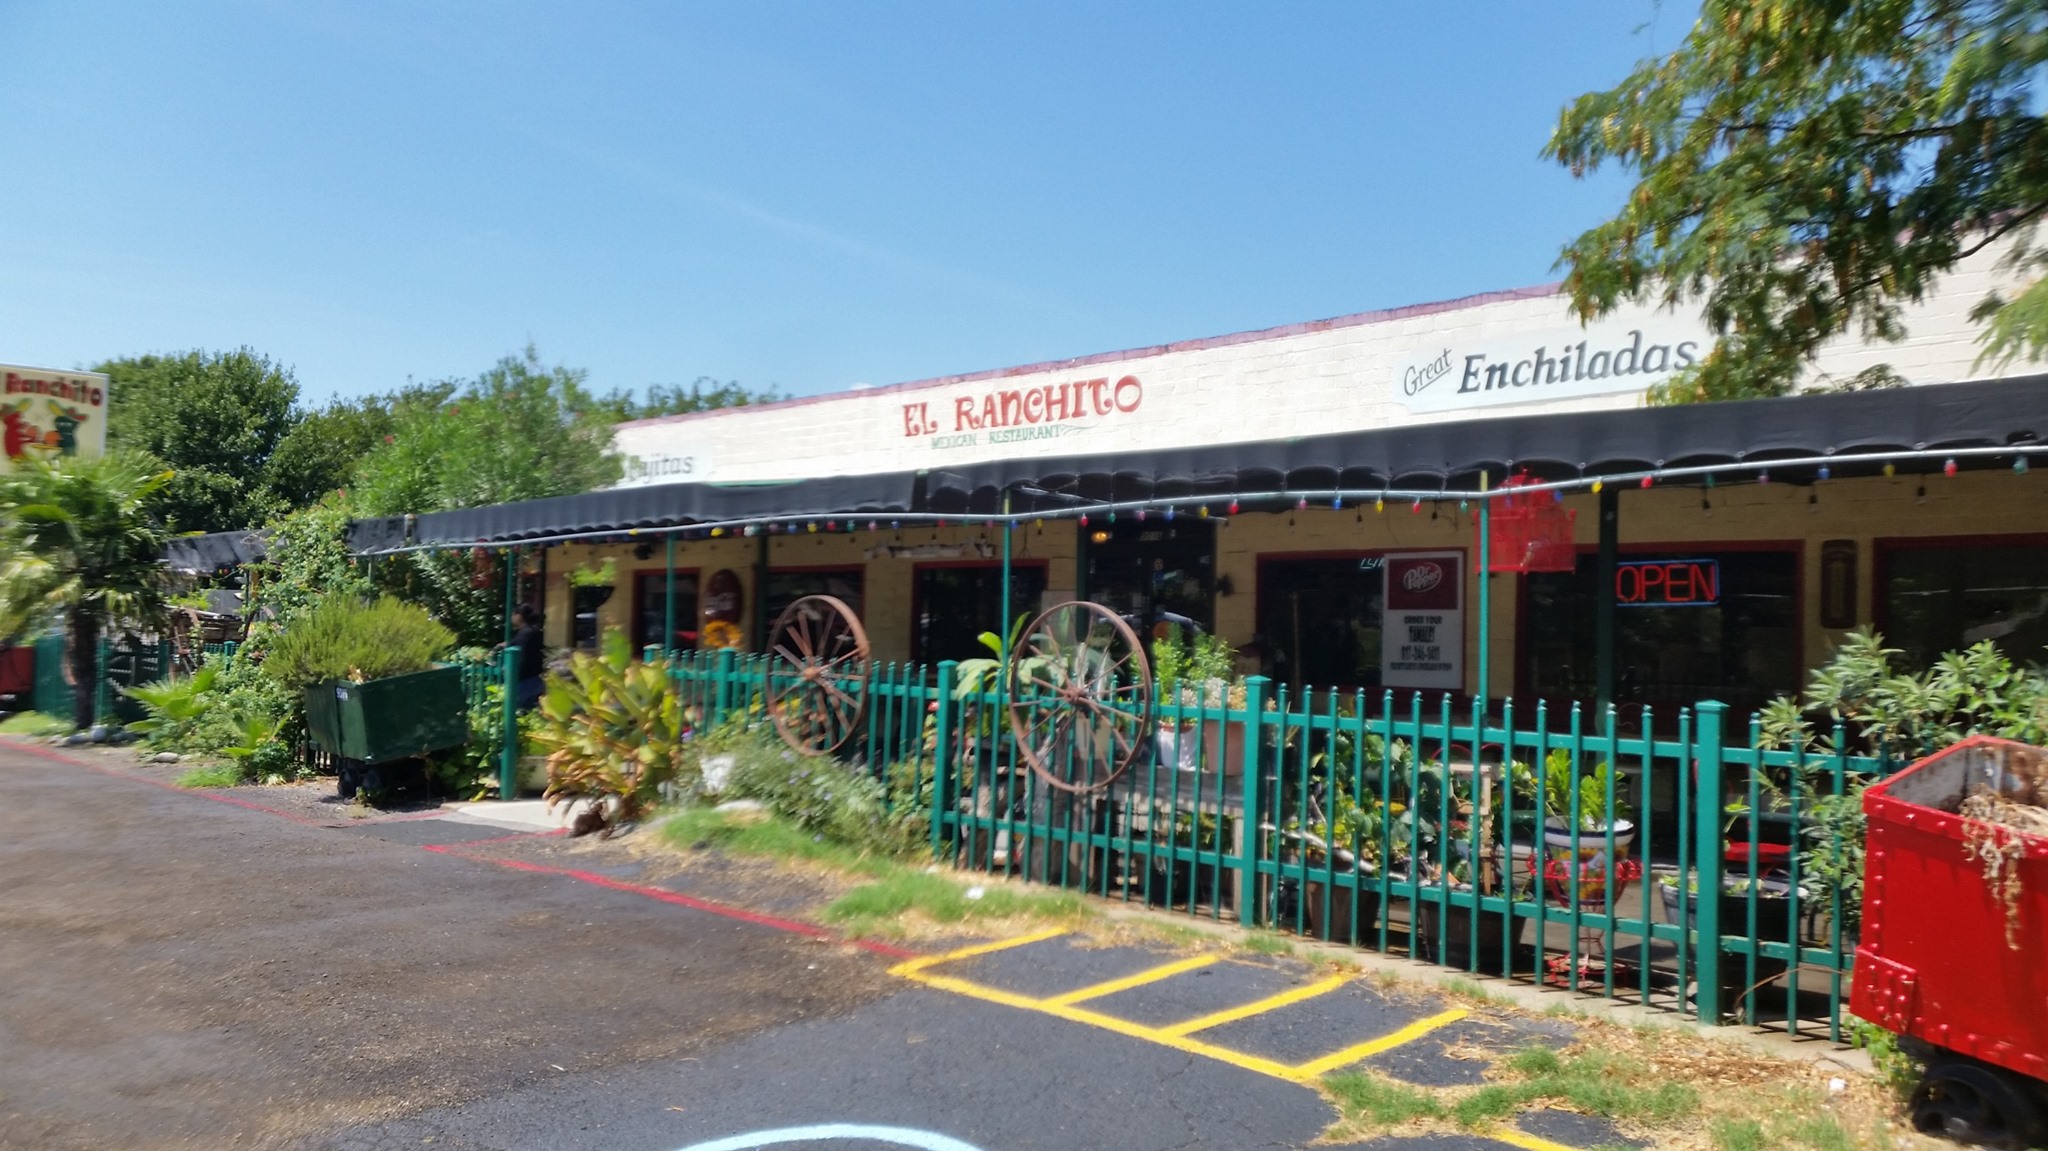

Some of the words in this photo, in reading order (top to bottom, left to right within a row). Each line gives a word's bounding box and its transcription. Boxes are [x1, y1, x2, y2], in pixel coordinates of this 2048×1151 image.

[1403, 348, 1452, 396] Great
[1457, 329, 1699, 394] Enchiladas
[5, 372, 102, 406] Ranchito
[902, 402, 937, 437] EL
[931, 433, 977, 449] MEXICAN
[989, 424, 1061, 444] RESTAURANT
[1615, 564, 1716, 603] OPEN
